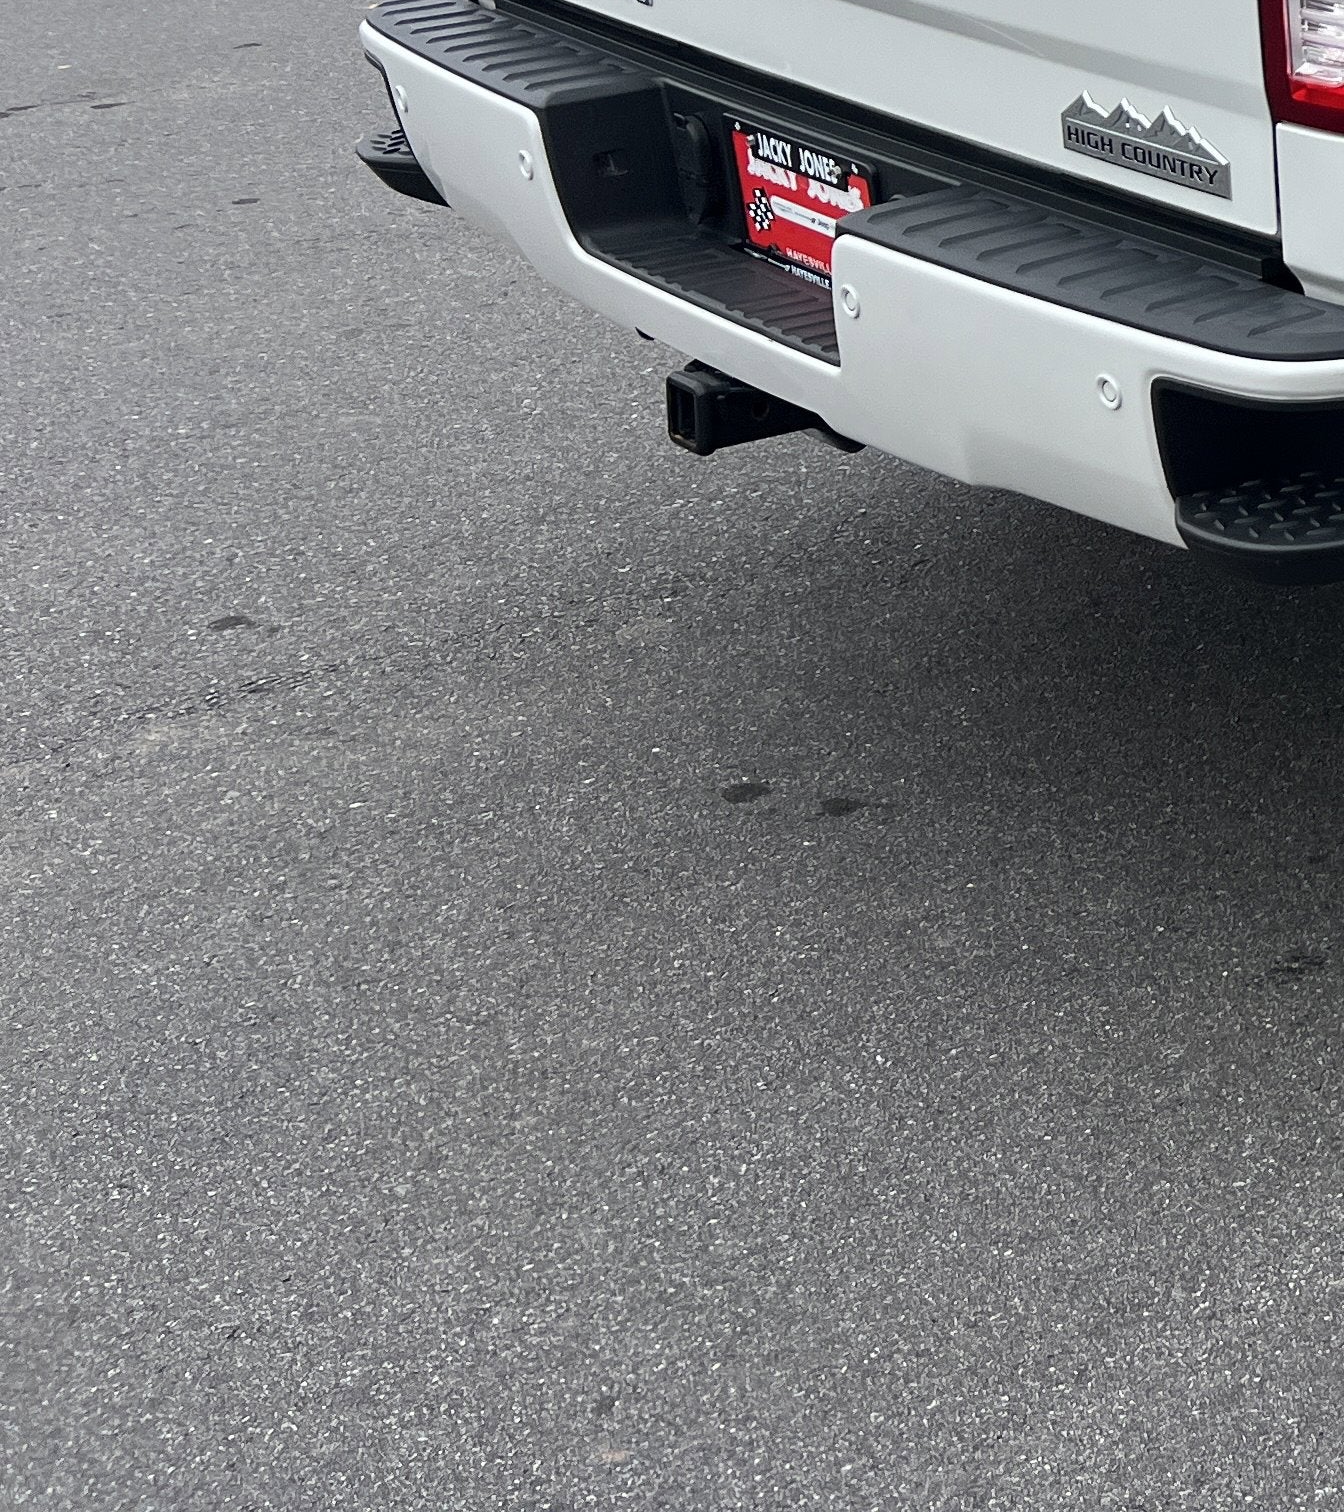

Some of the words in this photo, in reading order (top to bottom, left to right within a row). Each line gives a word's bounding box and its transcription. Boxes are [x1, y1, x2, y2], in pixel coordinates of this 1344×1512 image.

[757, 132, 793, 168] JACKY
[798, 147, 838, 185] JONES
[1066, 124, 1115, 155] HIGH
[1120, 141, 1219, 185] COUNTRY
